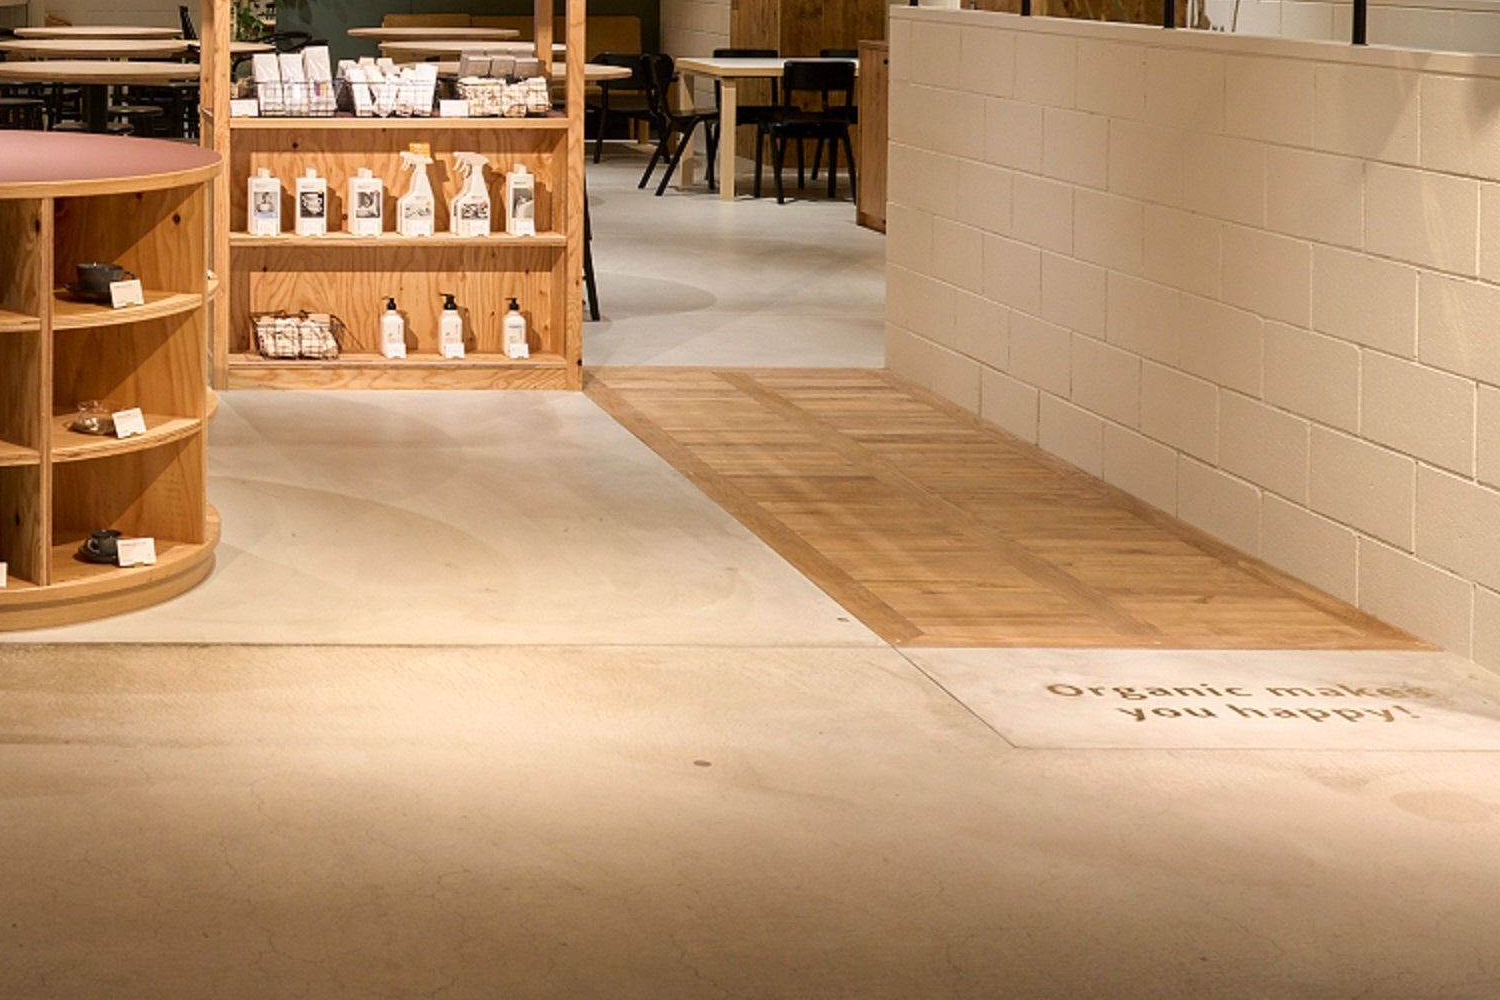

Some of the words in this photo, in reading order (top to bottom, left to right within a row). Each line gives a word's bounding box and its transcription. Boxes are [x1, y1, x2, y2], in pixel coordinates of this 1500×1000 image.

[1046, 683, 1253, 701] Organic
[1265, 682, 1434, 699] makes
[1116, 706, 1219, 722] you
[1225, 703, 1421, 723] happy!
